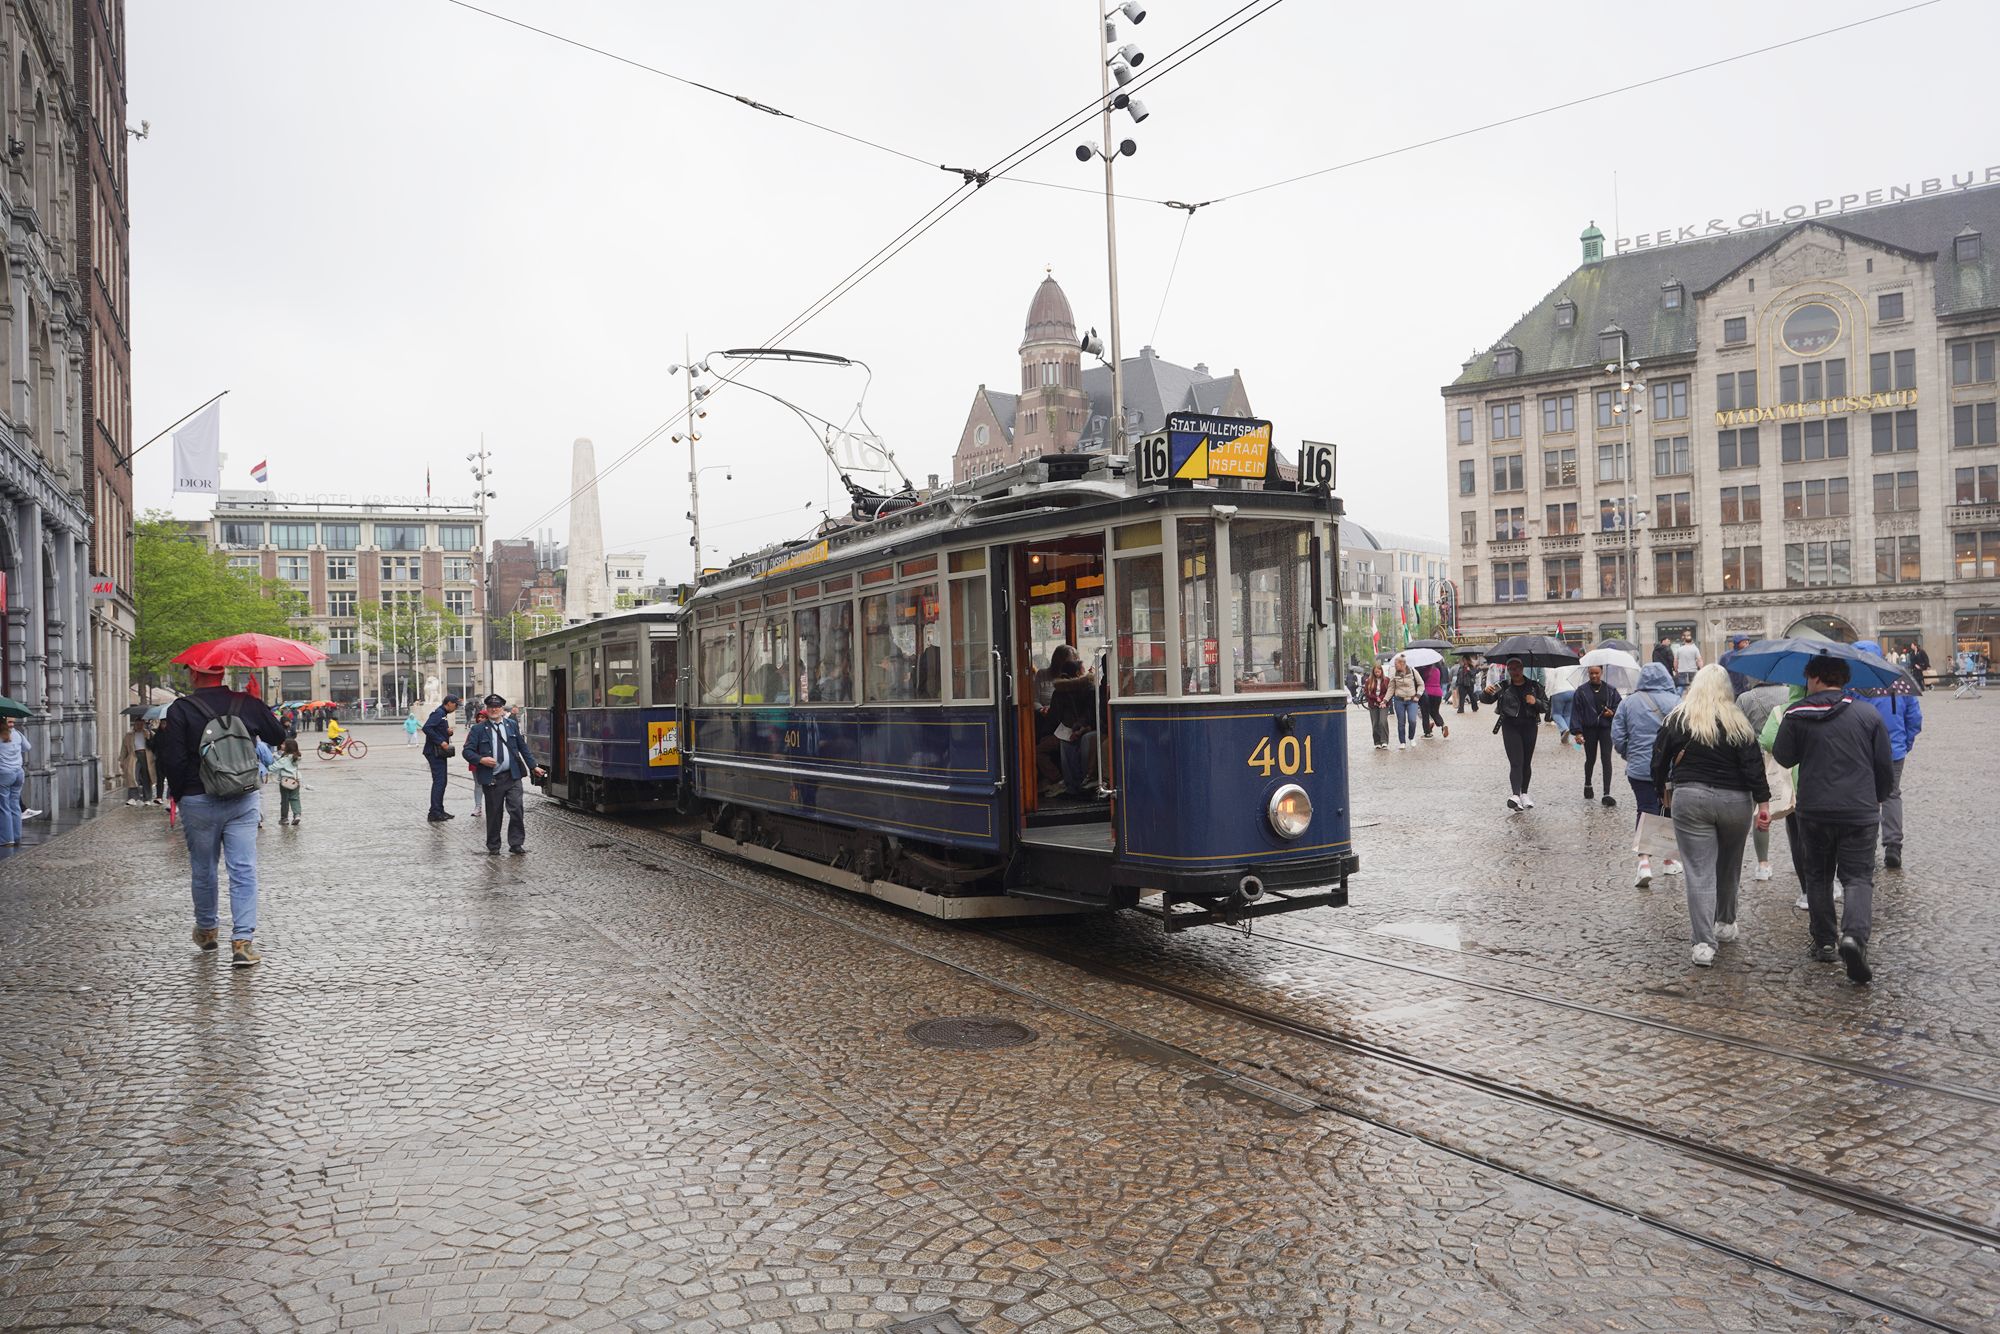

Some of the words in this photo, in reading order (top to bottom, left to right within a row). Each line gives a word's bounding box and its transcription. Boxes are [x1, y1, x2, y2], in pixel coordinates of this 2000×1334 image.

[1614, 225, 1696, 251] PEEK
[1706, 219, 1730, 235] &
[1715, 402, 1809, 426] MADAME
[1816, 389, 1918, 416] TUSSAUD
[1170, 418, 1196, 431] STAT
[1200, 420, 1269, 439] WILLEMSPARK
[1144, 437, 1166, 479] 16
[1209, 440, 1265, 456] LSTRAAT
[1305, 446, 1331, 484] 16
[180, 479, 212, 488] DIOR
[784, 730, 800, 747] 401
[1248, 735, 1314, 776] 401
